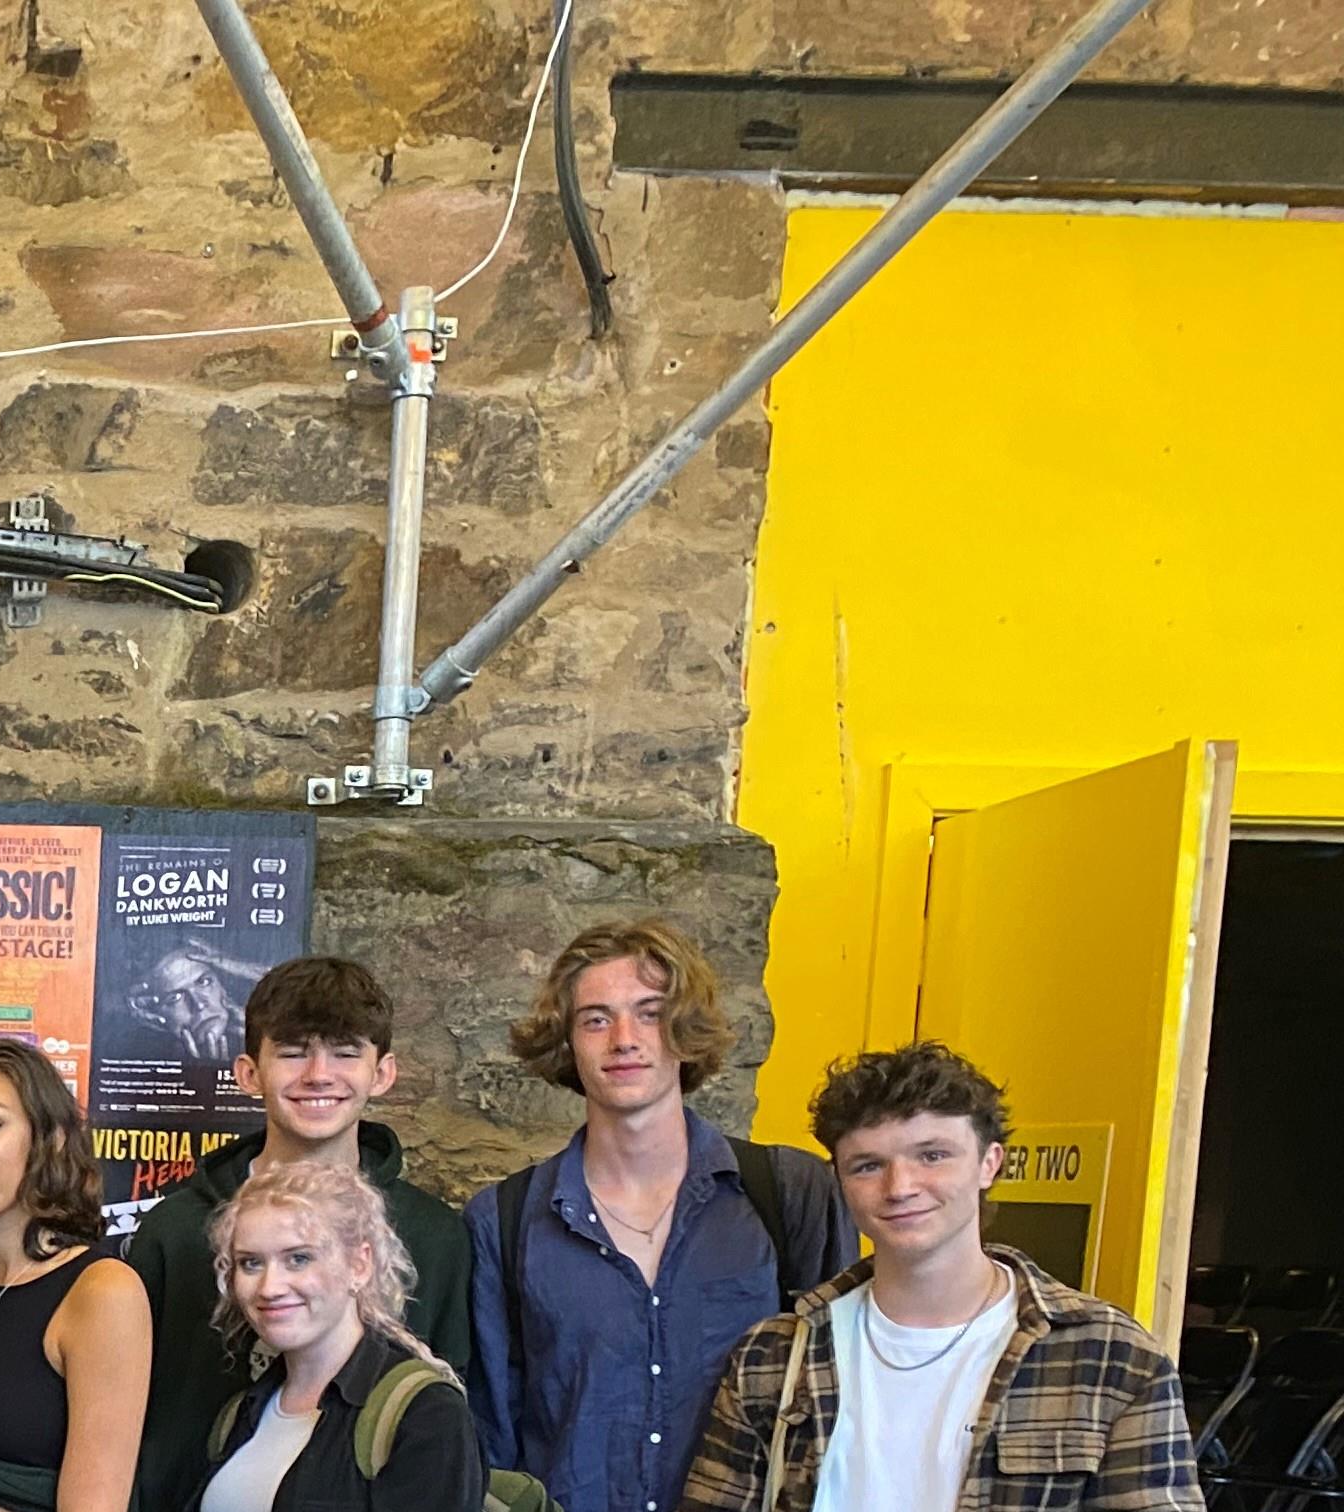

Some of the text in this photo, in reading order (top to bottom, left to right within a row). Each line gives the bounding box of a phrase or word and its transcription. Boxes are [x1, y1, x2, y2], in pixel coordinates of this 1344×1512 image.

[148, 859, 207, 871] REMAINS
[117, 868, 230, 898] LOGAN
[115, 893, 229, 914] DANKWORTH
[126, 910, 216, 926] BY LUKE WRIGHT
[91, 1128, 192, 1162] VICTORIA
[1002, 1144, 1081, 1181] ER TWO
